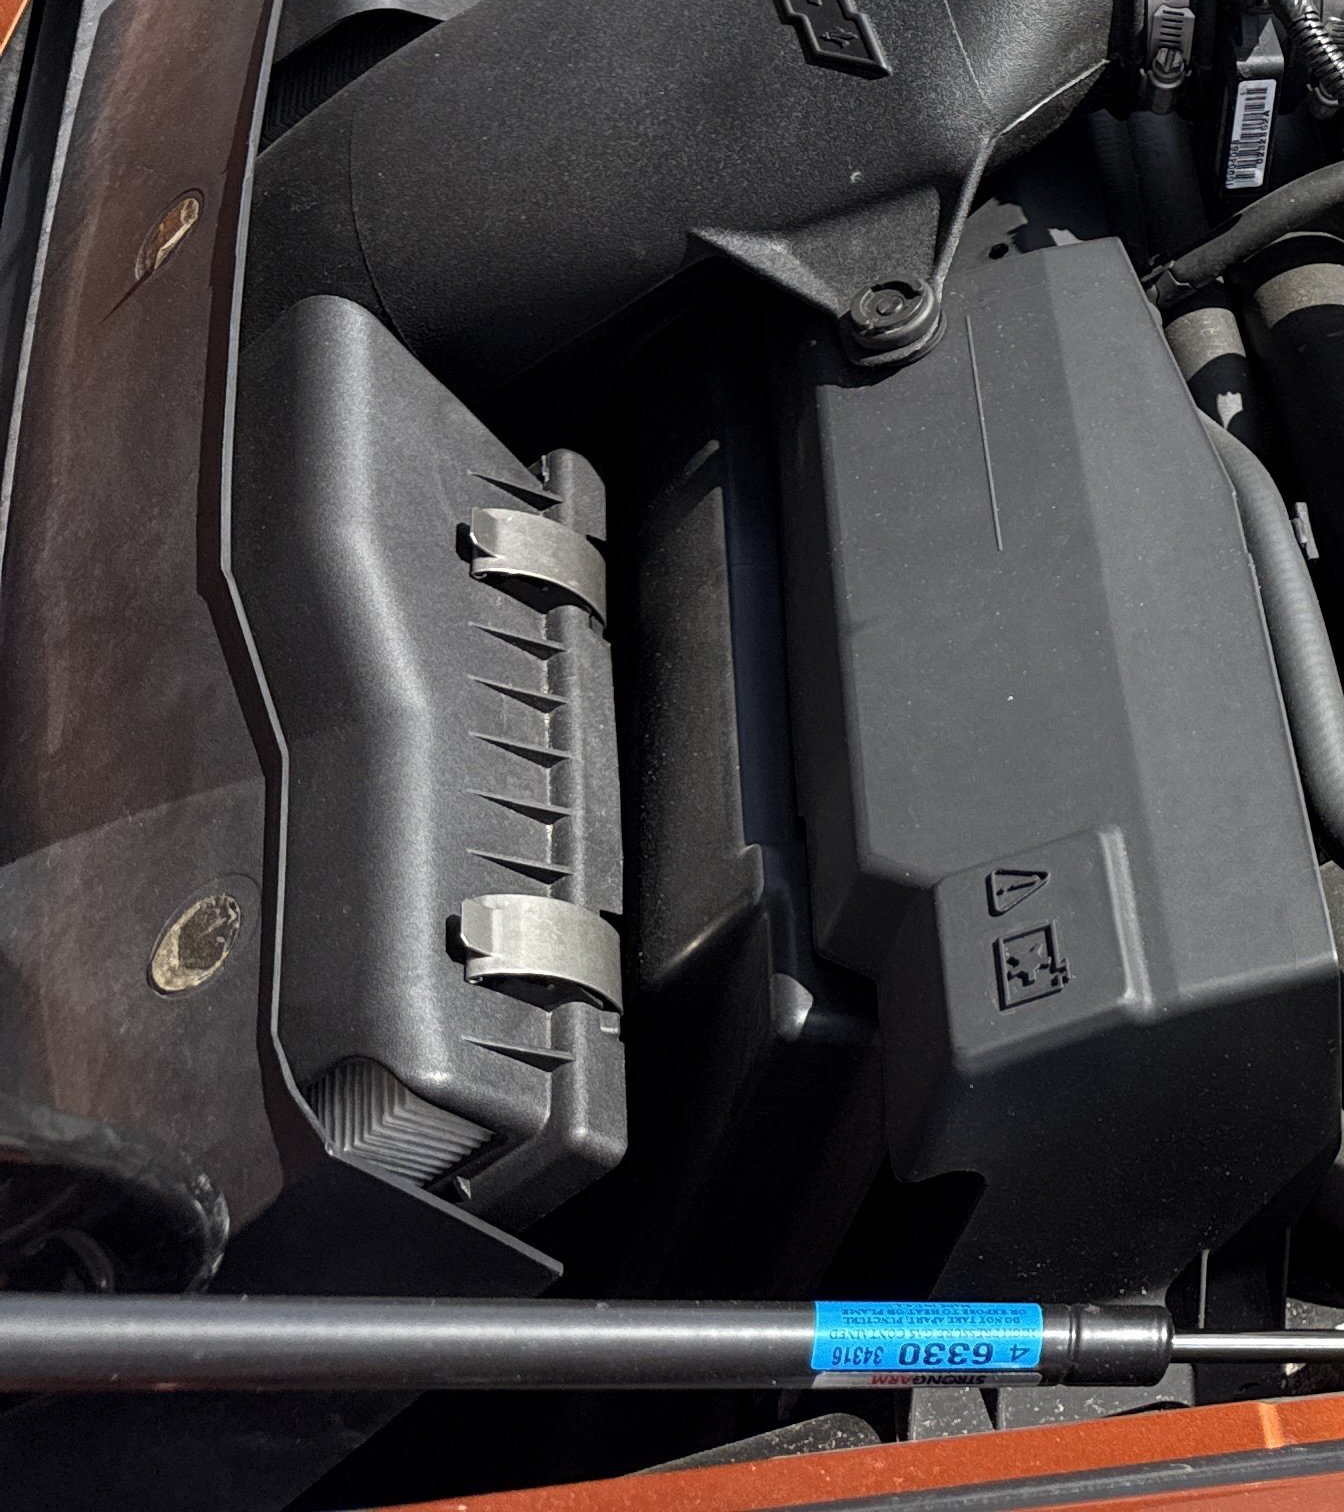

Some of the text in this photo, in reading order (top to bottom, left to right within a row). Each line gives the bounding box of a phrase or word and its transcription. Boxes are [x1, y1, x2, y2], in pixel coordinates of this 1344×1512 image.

[979, 1316, 1003, 1325] NOT
[829, 1328, 906, 1341] CONTAINED
[831, 1342, 1031, 1367] 4 6330 34316
[869, 1374, 987, 1386] STRONGARM
